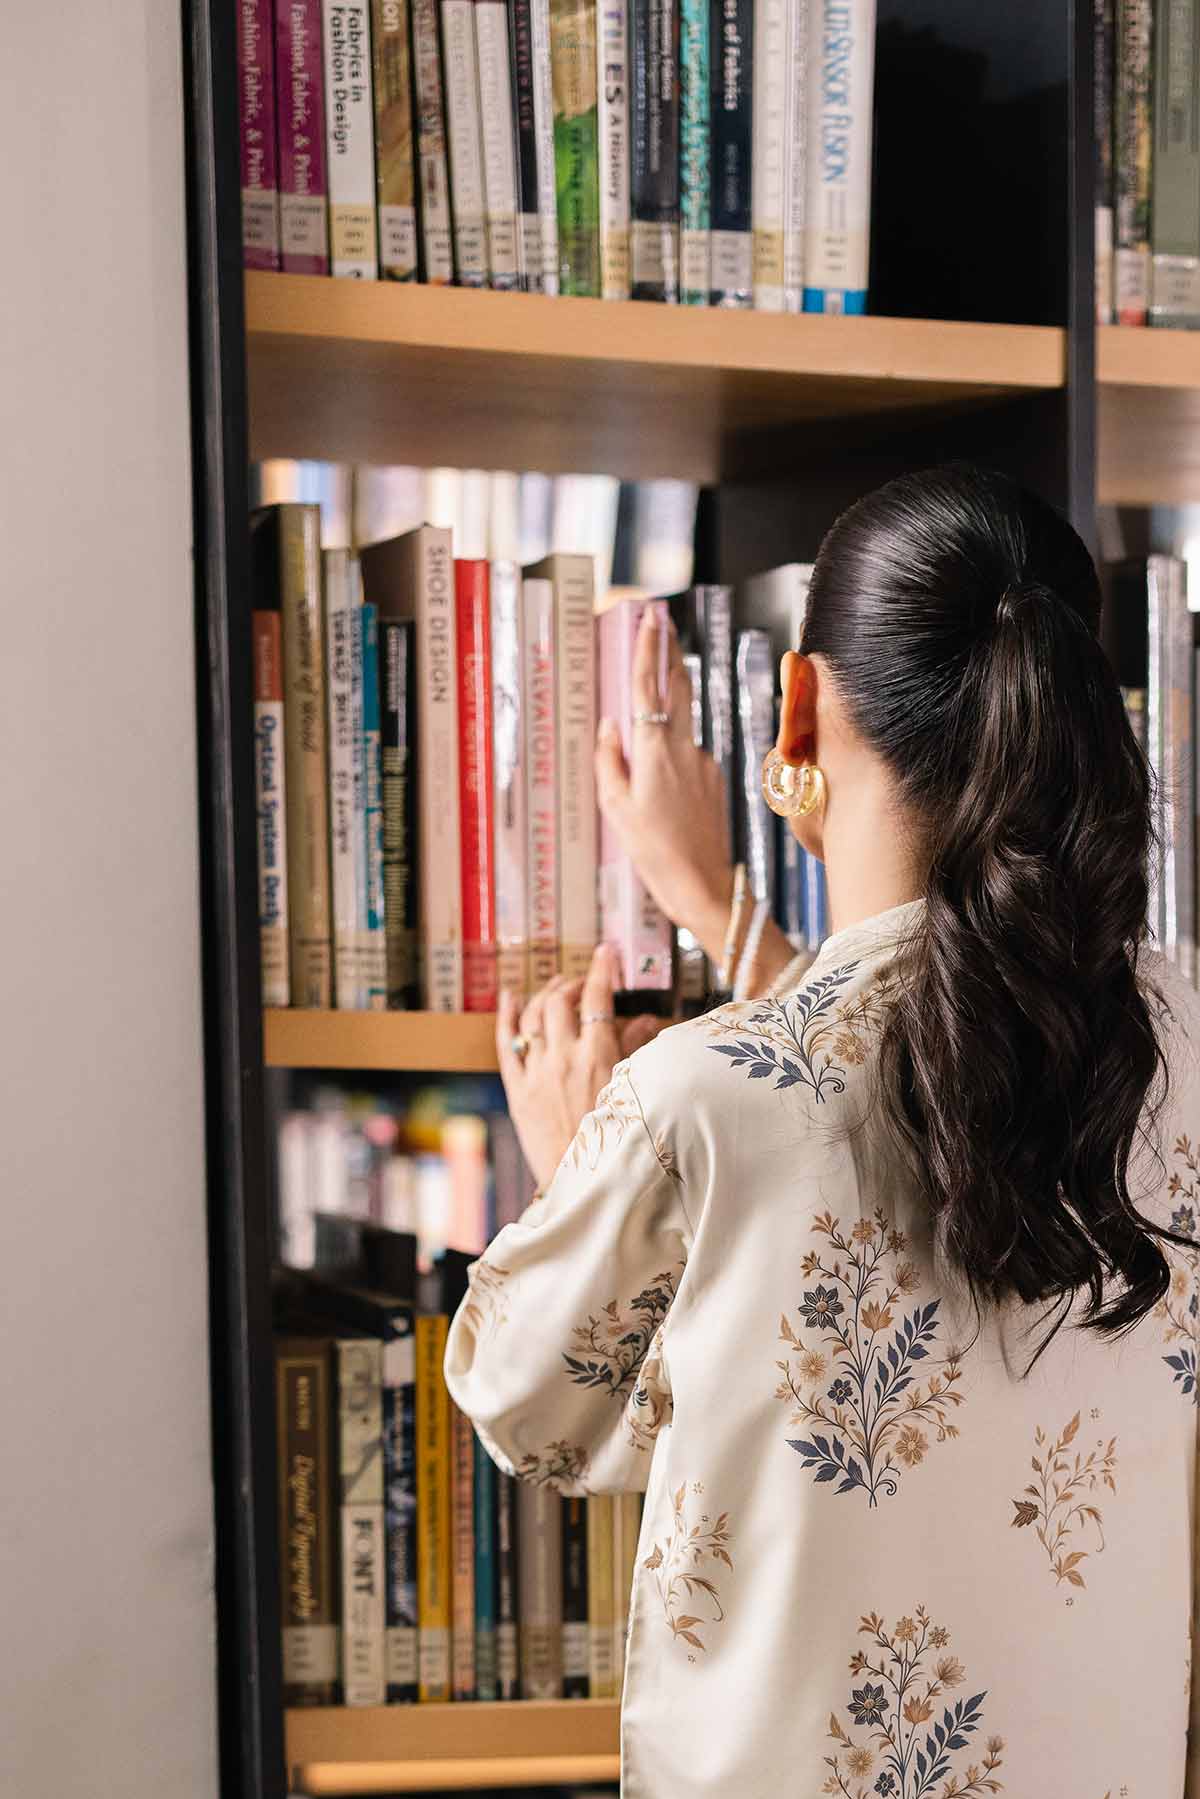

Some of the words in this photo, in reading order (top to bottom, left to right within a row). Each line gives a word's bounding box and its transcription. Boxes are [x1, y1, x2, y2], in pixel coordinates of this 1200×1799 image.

[330, 6, 349, 82] Fashion
[347, 7, 365, 79] Fabrics
[350, 85, 367, 103] in
[724, 46, 742, 111] Fabrics
[334, 89, 351, 155] Design
[821, 114, 855, 185] FUSION
[608, 132, 625, 201] History
[428, 546, 448, 607] SHOE
[430, 617, 449, 703] DESIGN
[256, 715, 279, 792] Optical
[257, 799, 281, 869] System
[353, 1519, 375, 1597] FONT
